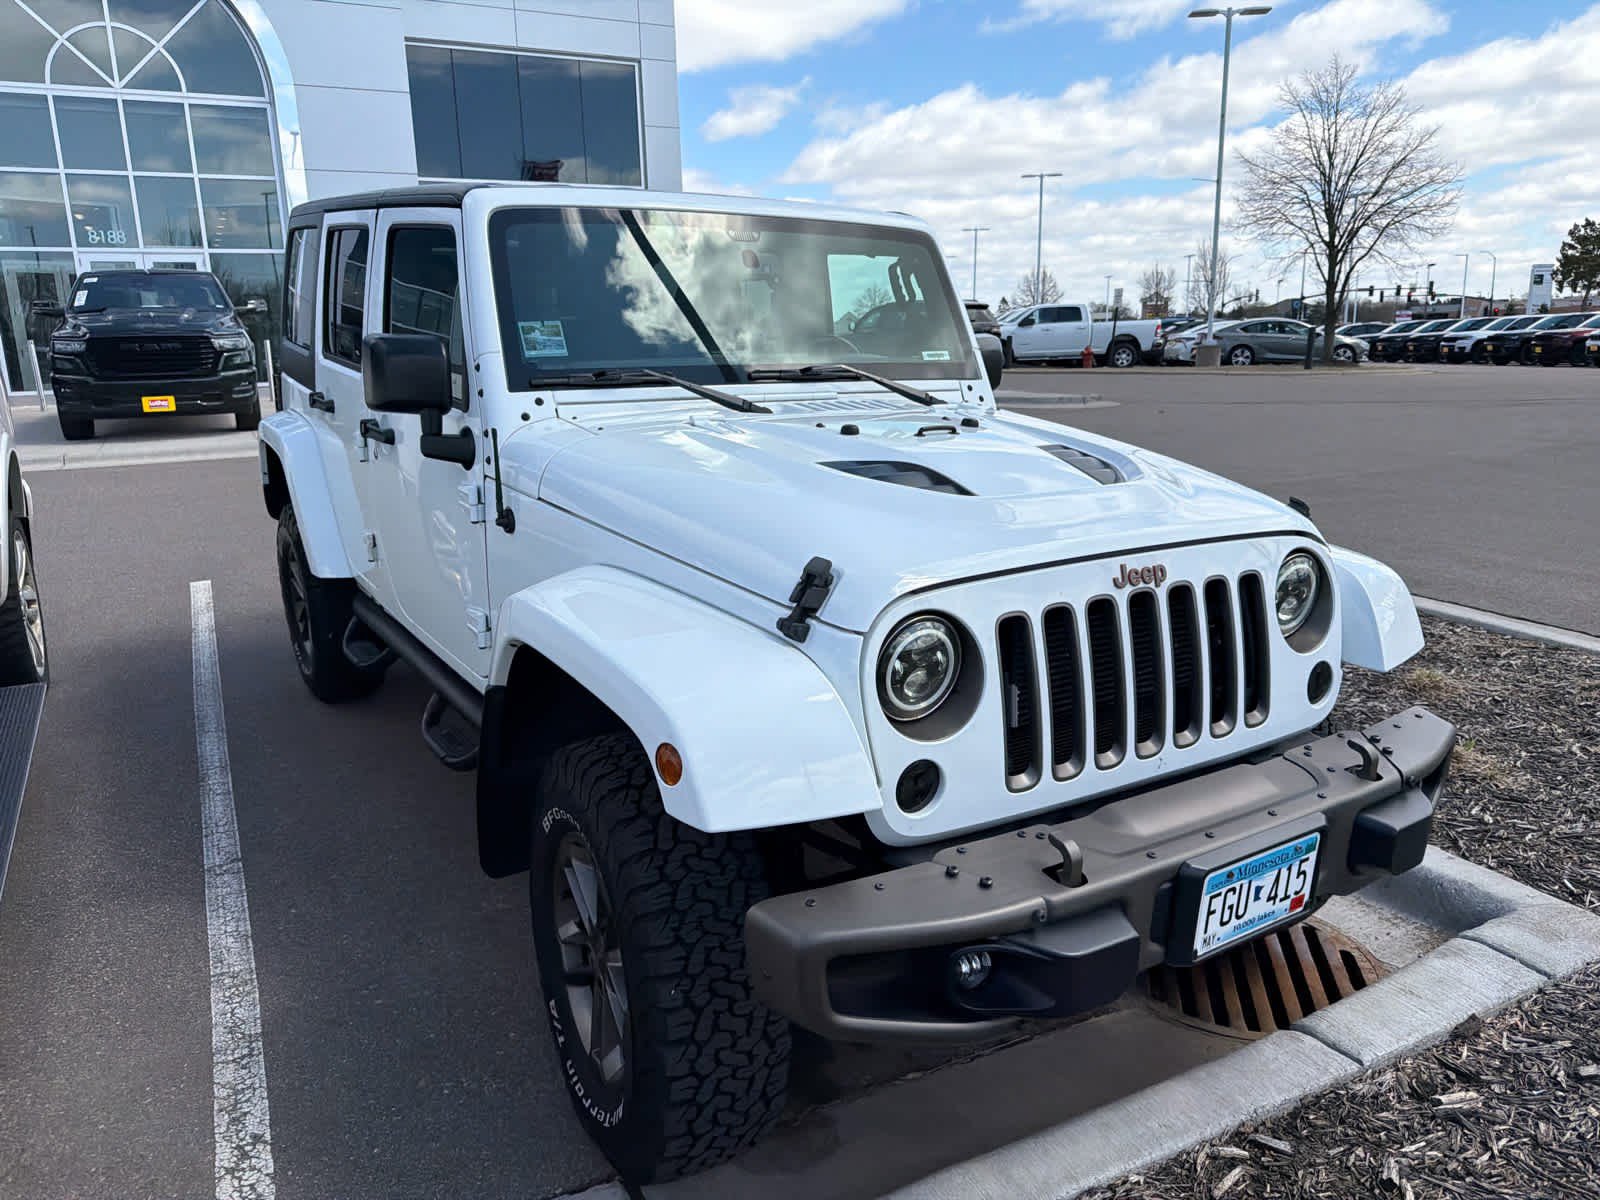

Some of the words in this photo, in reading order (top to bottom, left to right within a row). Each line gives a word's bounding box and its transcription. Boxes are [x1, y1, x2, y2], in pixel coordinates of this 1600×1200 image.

[88, 230, 127, 244] 8188
[1112, 563, 1167, 589] Jeep
[1238, 852, 1290, 879] Minnesota
[1203, 880, 1252, 934] FGU
[1266, 857, 1310, 905] 415
[1202, 934, 1217, 949] MAY
